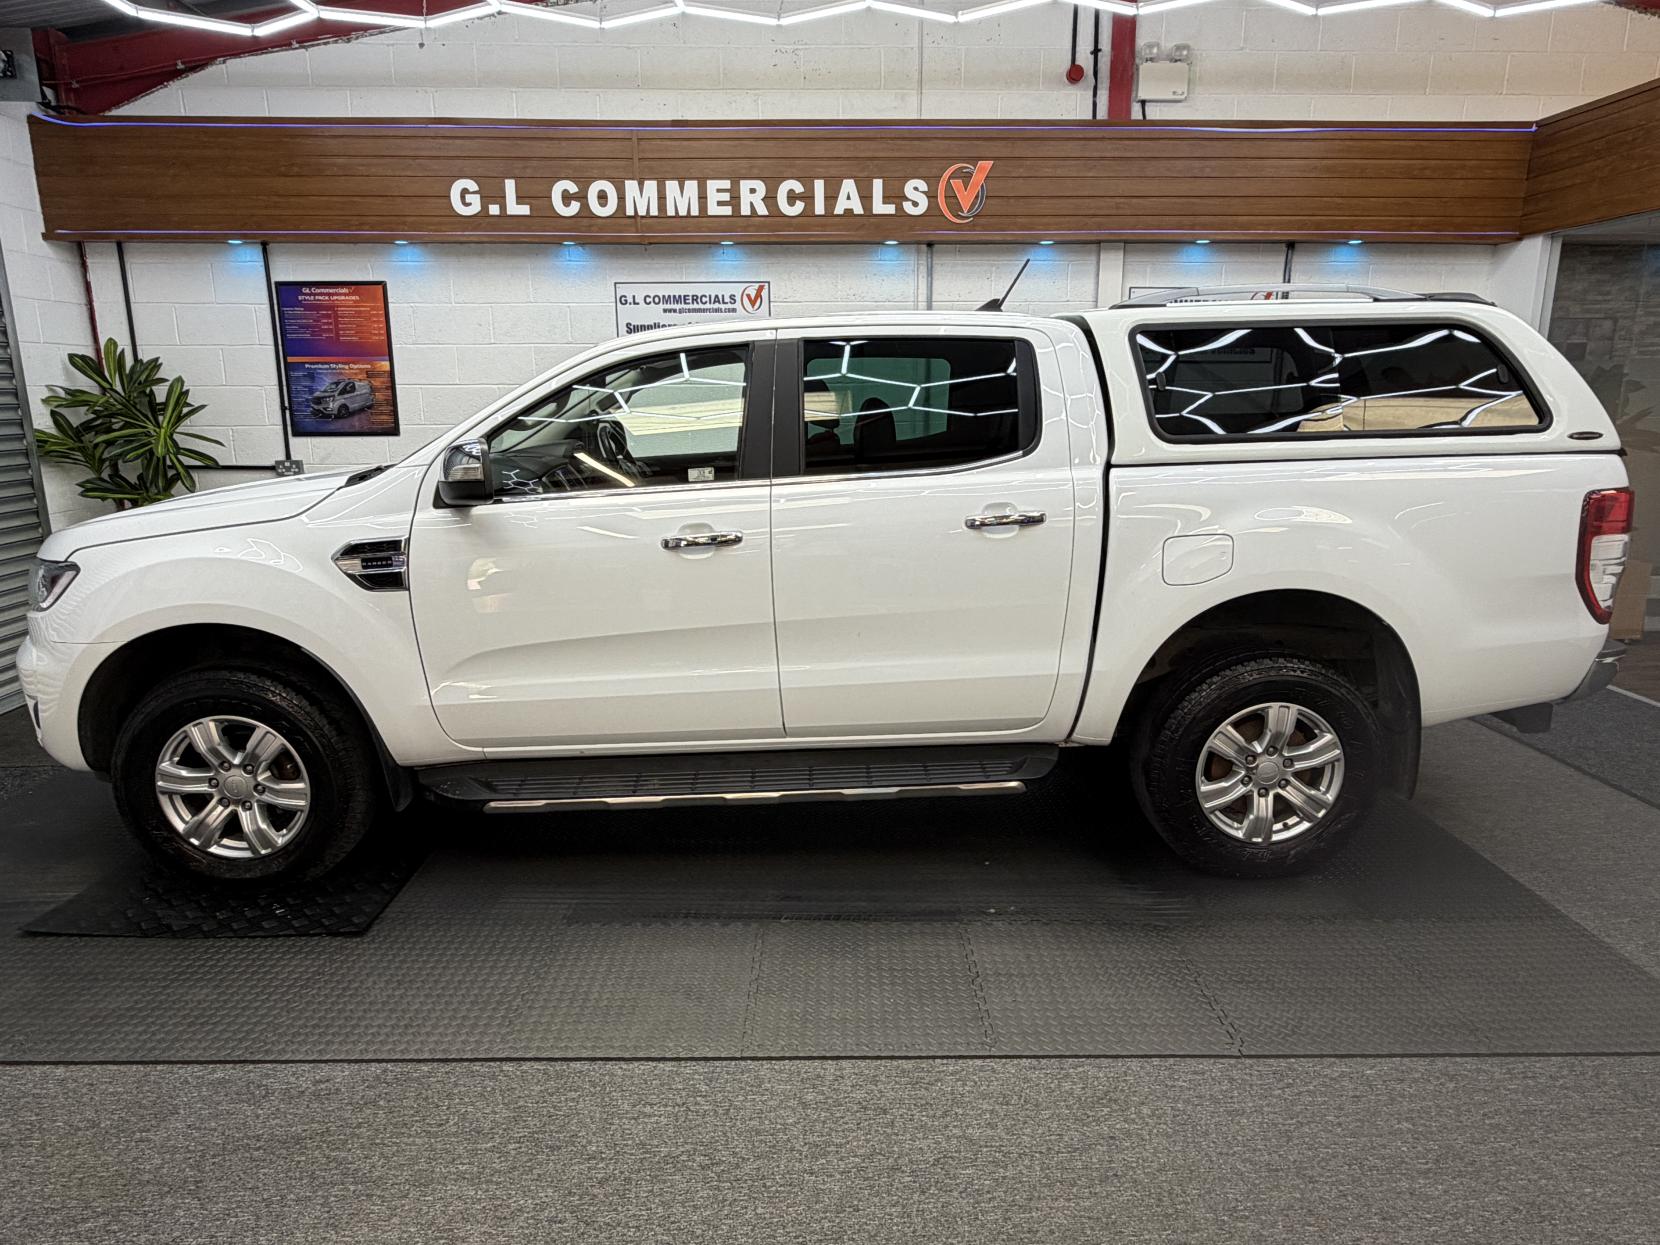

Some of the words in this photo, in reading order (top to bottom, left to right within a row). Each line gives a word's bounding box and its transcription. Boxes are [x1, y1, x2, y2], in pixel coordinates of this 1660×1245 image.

[450, 178, 531, 216] G.L
[551, 178, 929, 217] COMMERCIALS
[618, 294, 640, 306] G.L
[643, 293, 737, 306] COMMERCIALS
[662, 307, 737, 315] www.glcommercials.com
[625, 322, 677, 335] Suppli
